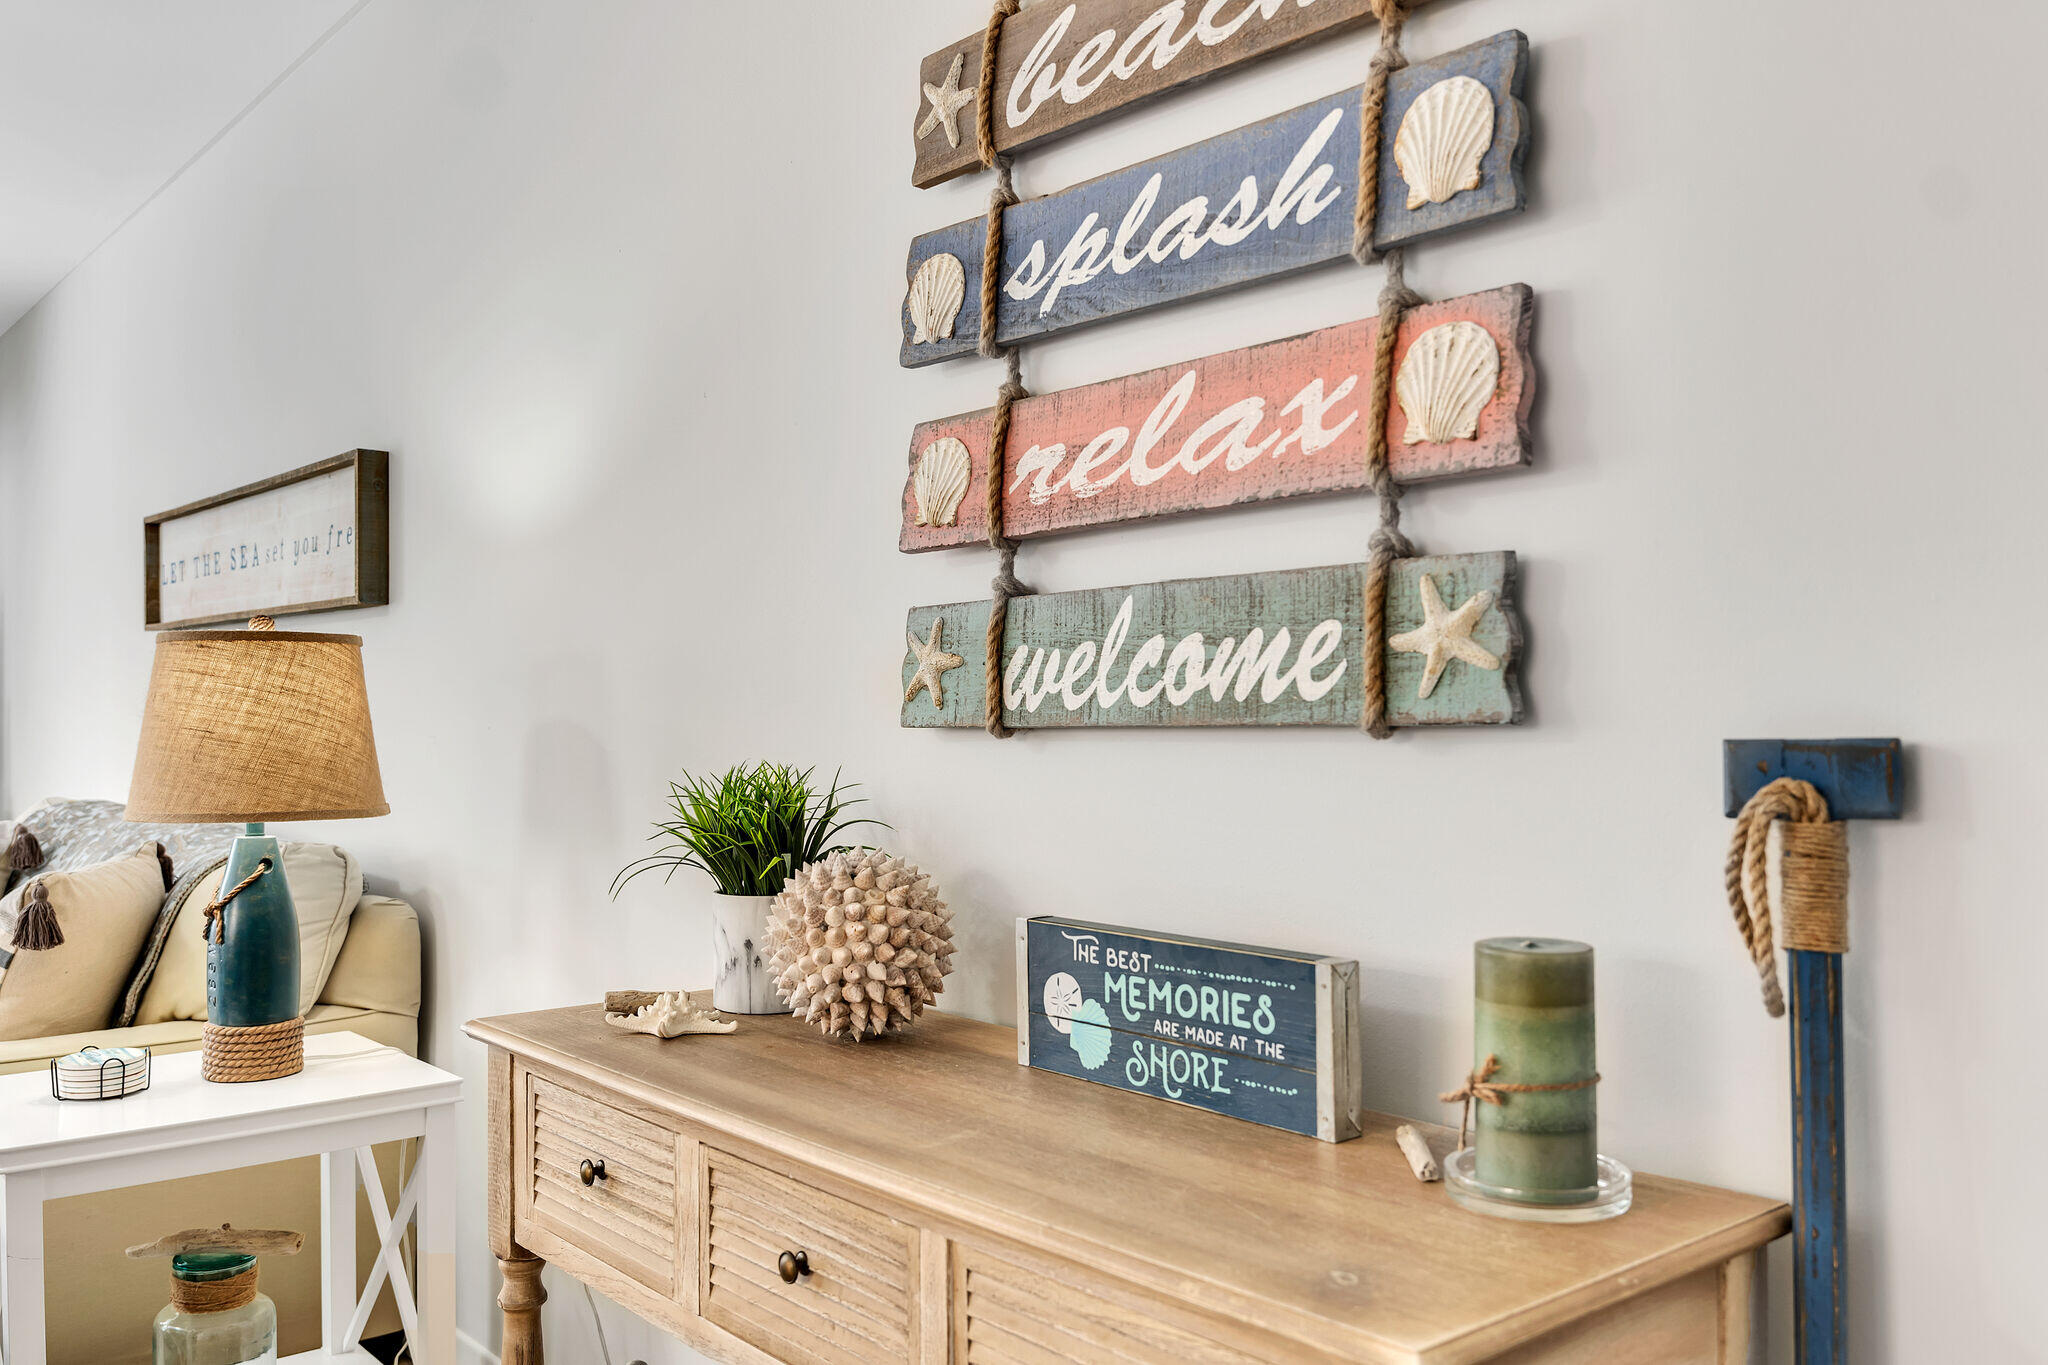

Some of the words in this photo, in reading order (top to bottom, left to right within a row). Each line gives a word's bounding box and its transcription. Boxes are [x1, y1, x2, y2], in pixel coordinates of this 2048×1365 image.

[1006, 0, 1317, 128] beac
[1003, 108, 1342, 319] splash
[1009, 369, 1360, 505] relax
[161, 560, 185, 586] LET
[193, 551, 221, 579] THE
[230, 541, 260, 570] SEA
[264, 537, 285, 564] set
[293, 535, 319, 566] you
[1003, 595, 1349, 713] welcome
[1061, 930, 1100, 964] THE
[1106, 947, 1152, 974] BEST
[1104, 971, 1276, 1035] MEMORIES
[1125, 1040, 1231, 1099] SHORE
[1153, 1018, 1181, 1039] ARE
[1184, 1025, 1225, 1048] MADE
[1229, 1033, 1249, 1052] AT
[1254, 1039, 1286, 1061] THE
